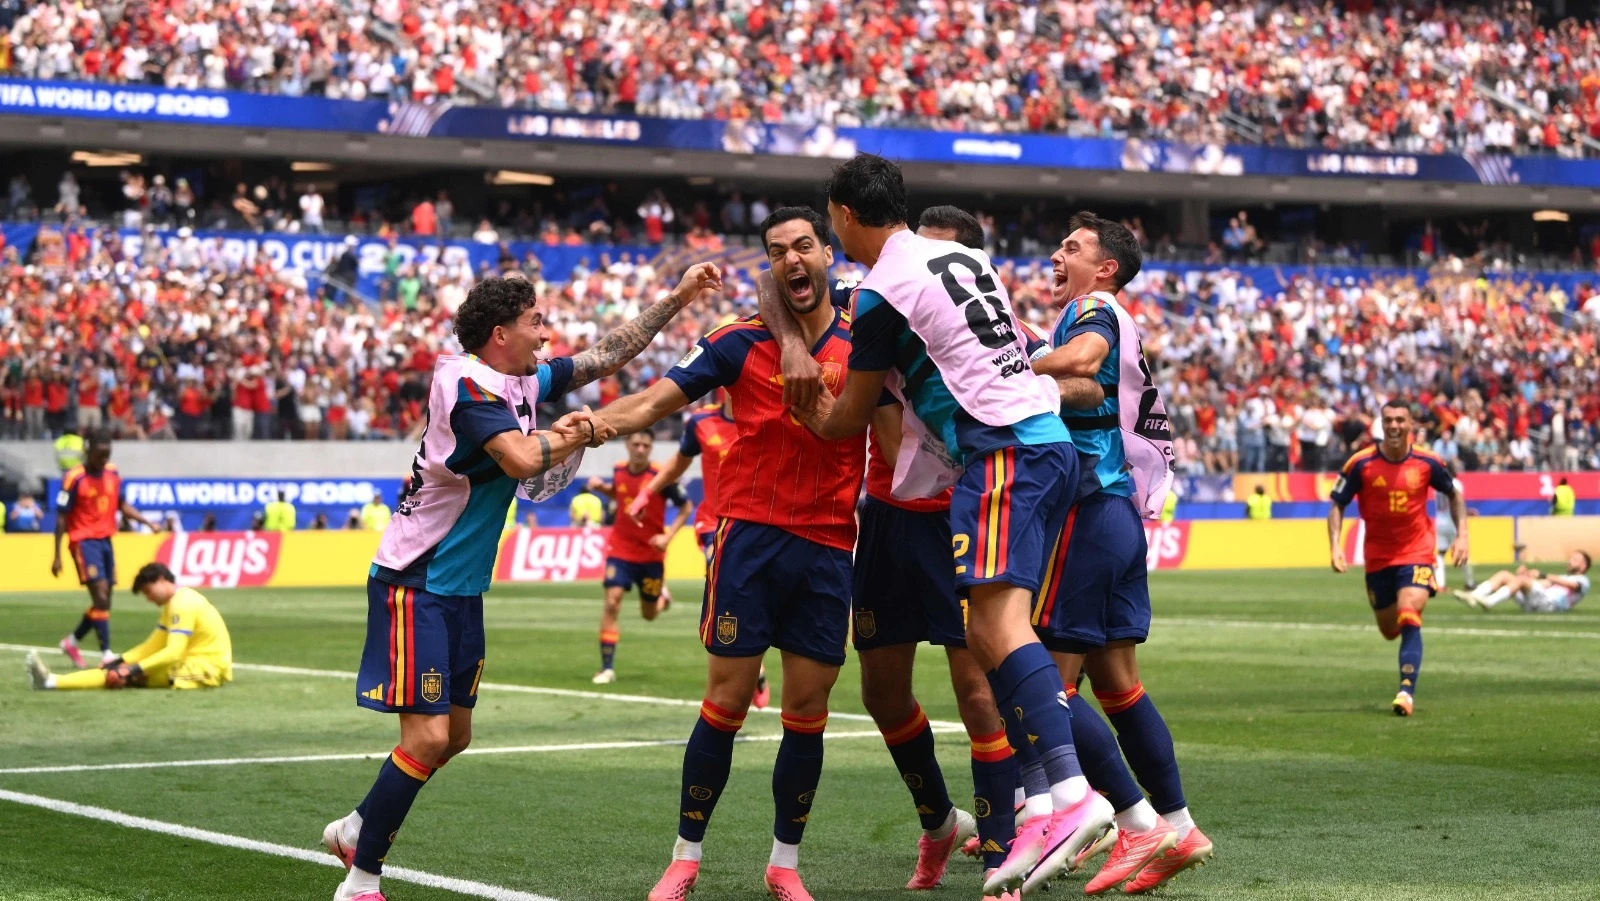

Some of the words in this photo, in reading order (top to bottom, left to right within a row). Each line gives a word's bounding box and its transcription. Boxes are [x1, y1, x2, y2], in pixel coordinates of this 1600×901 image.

[36, 86, 112, 111] WORLD
[113, 91, 156, 113] CUP
[156, 94, 229, 118] 2026
[1144, 419, 1170, 432] FIFA
[125, 482, 176, 505] FIFA
[176, 482, 255, 505] WORLD
[256, 482, 300, 505] CUP
[301, 482, 375, 505] 2026
[1388, 490, 1408, 513] 12
[168, 530, 269, 588] Lay's
[511, 526, 605, 582] Lay's
[1411, 564, 1432, 586] 12
